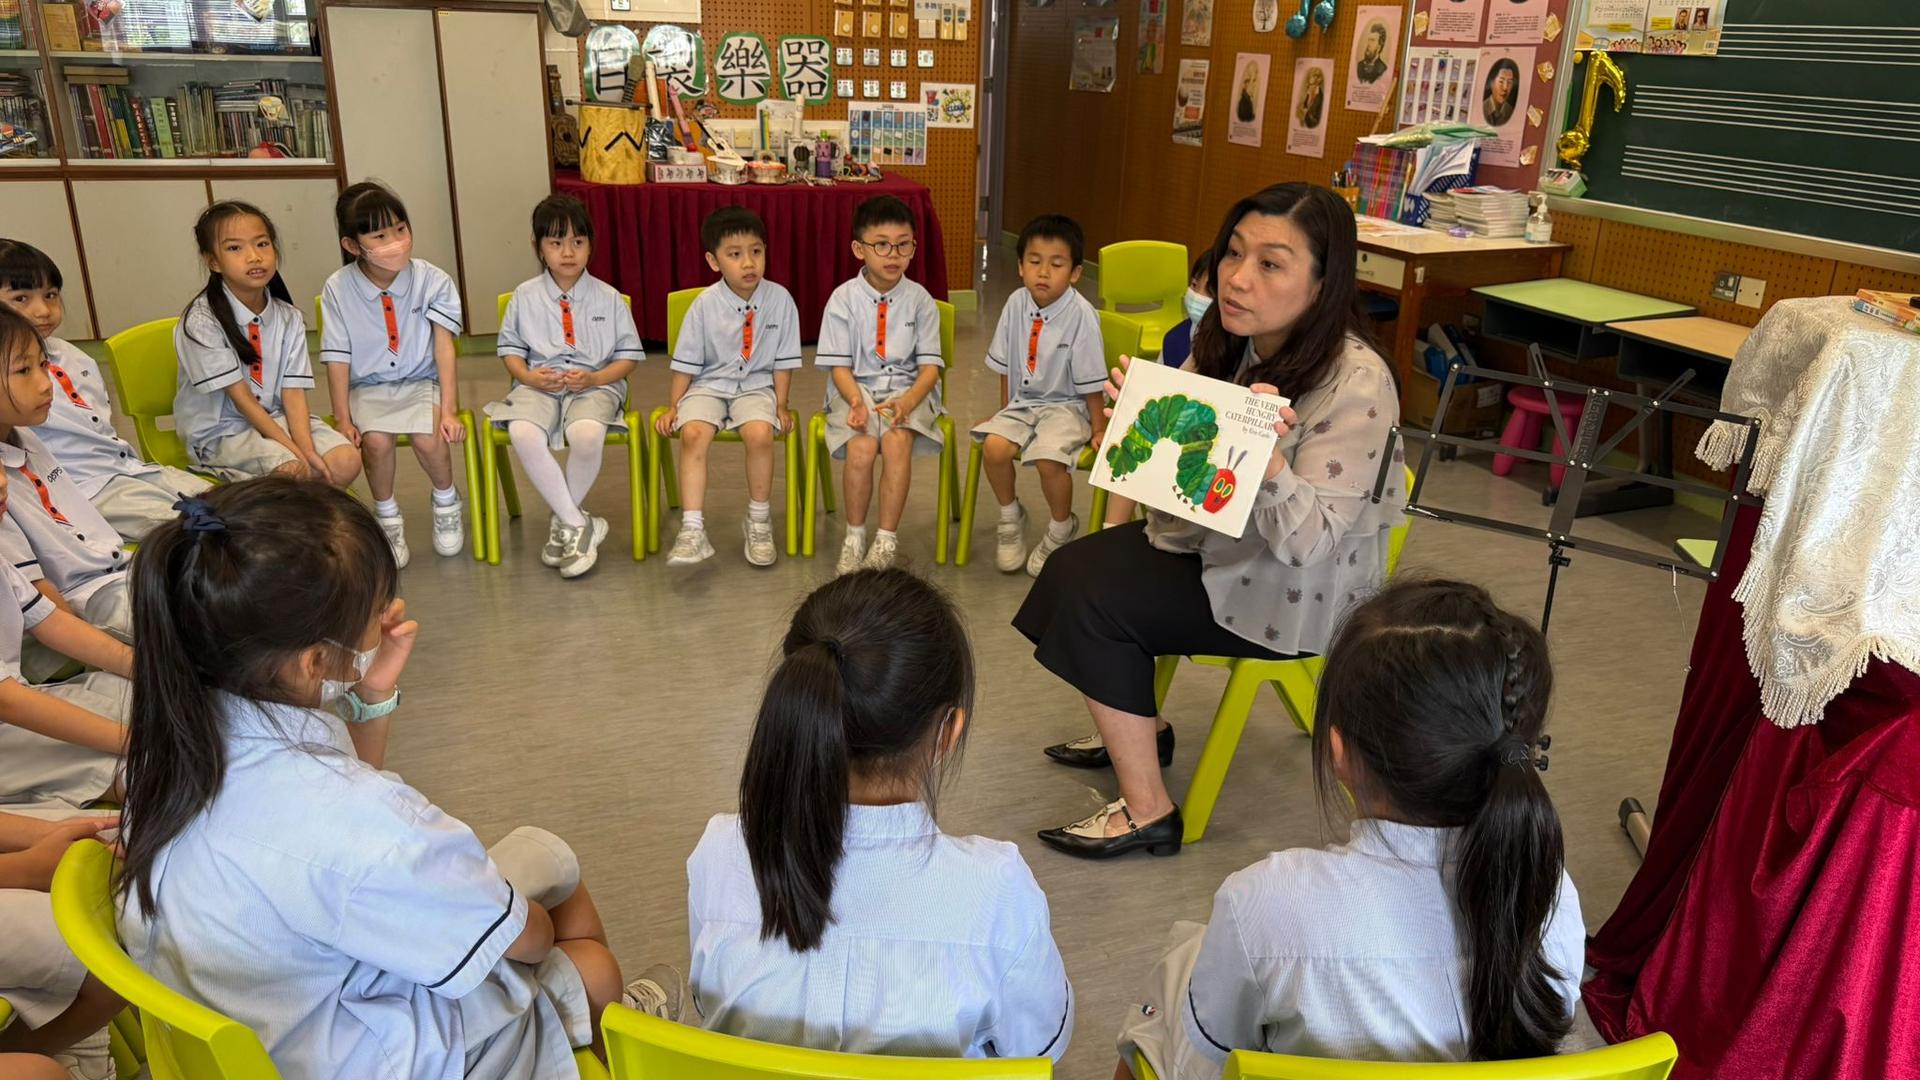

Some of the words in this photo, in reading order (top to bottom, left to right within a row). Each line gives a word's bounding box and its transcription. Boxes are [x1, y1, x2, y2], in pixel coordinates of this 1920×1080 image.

[1244, 396, 1260, 408] THE
[1260, 400, 1279, 413] VERY
[1225, 410, 1274, 431] CATERPILLAR
[1245, 406, 1276, 422] HUNGRY
